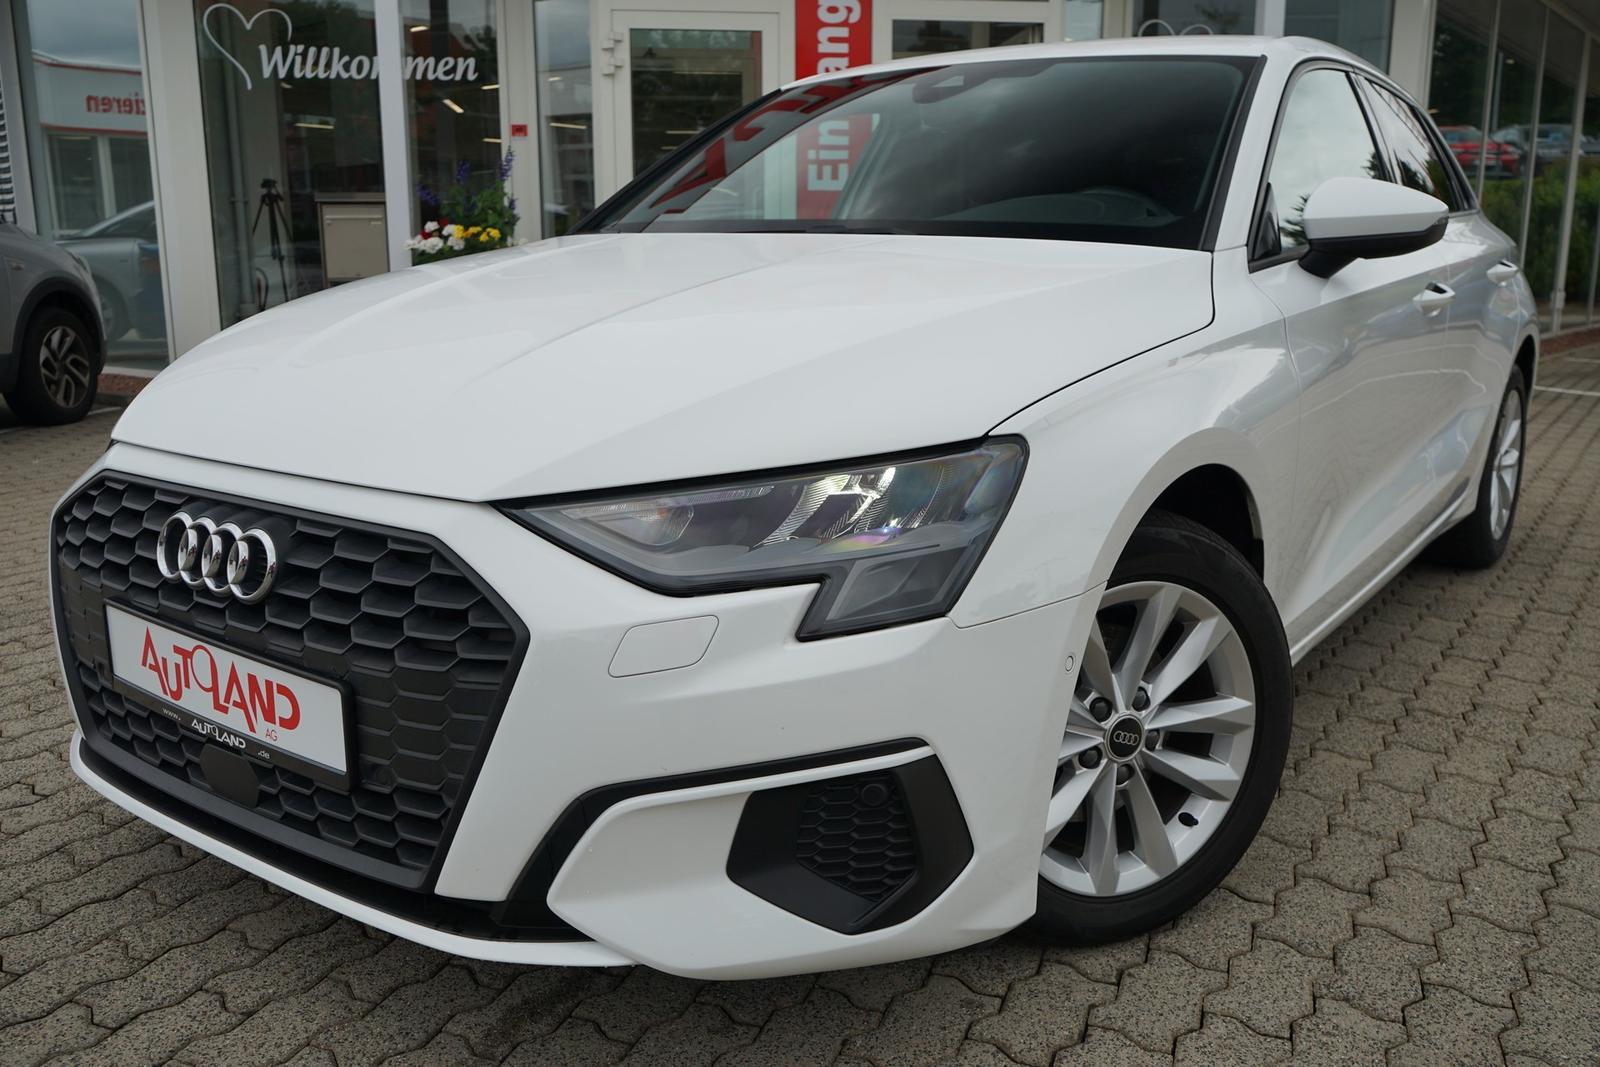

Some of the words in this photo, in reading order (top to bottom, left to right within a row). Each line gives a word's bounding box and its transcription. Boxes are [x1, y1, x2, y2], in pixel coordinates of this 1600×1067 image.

[258, 44, 478, 81] Willkomen
[807, 0, 861, 191] Einang
[142, 627, 300, 733] AUTOLAND
[191, 719, 246, 749] AUTOLAND
[265, 729, 278, 742] AG
